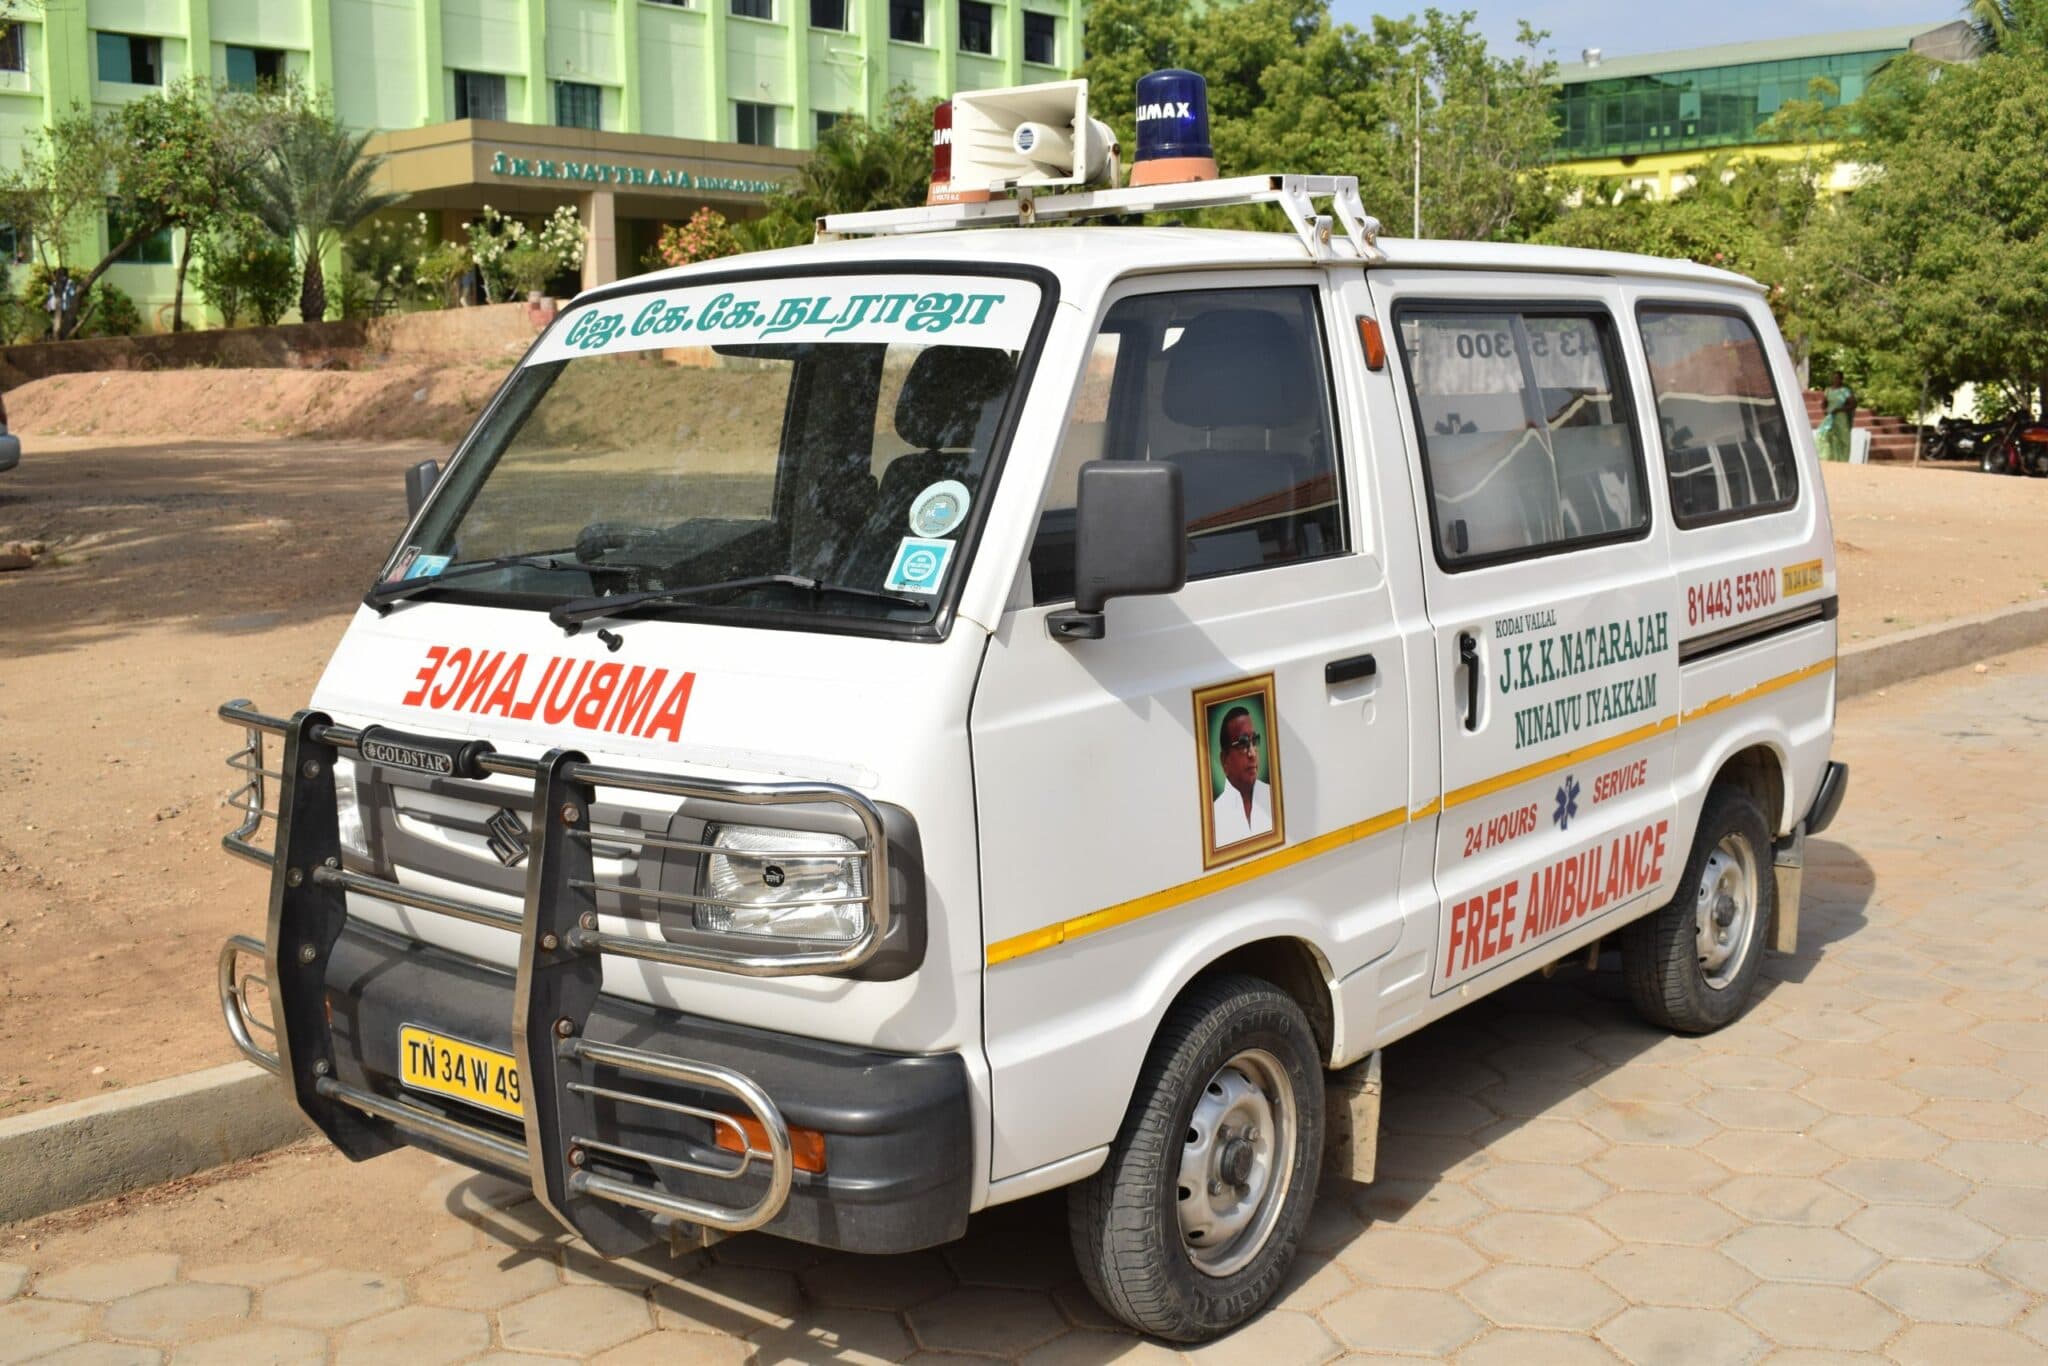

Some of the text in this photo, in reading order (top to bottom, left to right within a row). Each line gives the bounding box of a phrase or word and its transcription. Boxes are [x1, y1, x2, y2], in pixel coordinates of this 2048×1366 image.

[1495, 609, 1557, 639] KODAI VALLAL
[1688, 578, 1732, 626] 81443
[1736, 568, 1776, 613] 55300
[1500, 611, 1669, 694] J.K.K.NATARAJAH
[1514, 673, 1657, 750] NINAIVU IYAKKAM
[376, 745, 445, 771] GOLDSTAR
[1463, 759, 1648, 858] 24 HOURS SERVICE
[1446, 820, 1668, 978] FREE AMBULANCE
[471, 1057, 488, 1093] W
